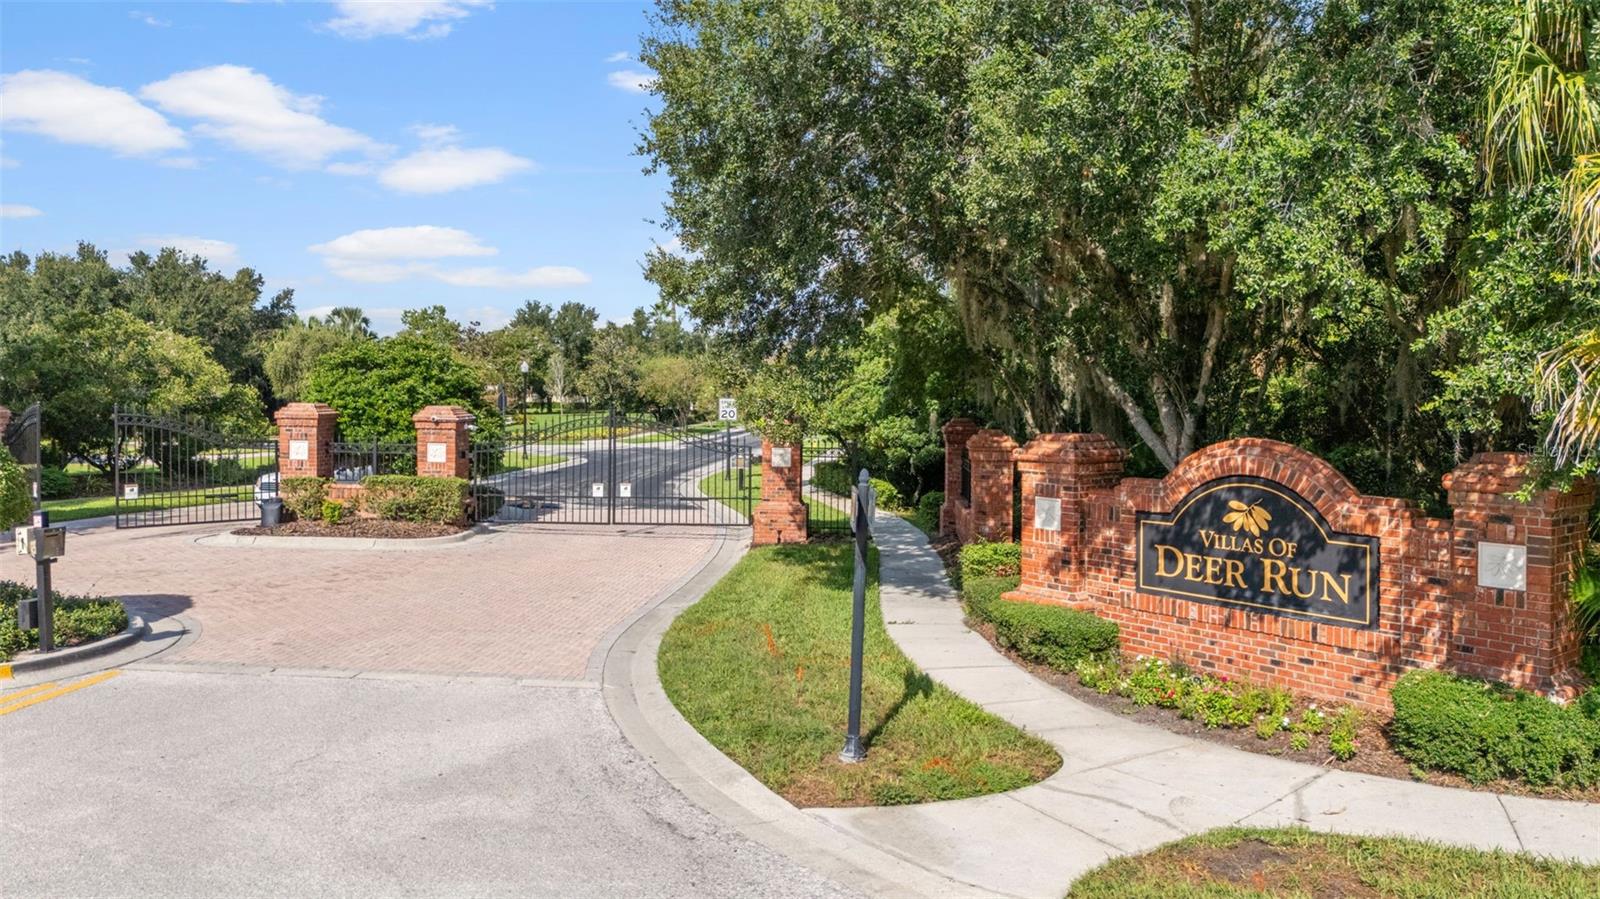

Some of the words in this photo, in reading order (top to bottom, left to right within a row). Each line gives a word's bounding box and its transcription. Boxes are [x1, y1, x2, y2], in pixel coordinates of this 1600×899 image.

[721, 409, 736, 419] 20
[1200, 530, 1264, 554] VILLAS
[1268, 538, 1297, 558] OF
[1155, 545, 1248, 589] DEER
[1260, 558, 1352, 604] RUN
